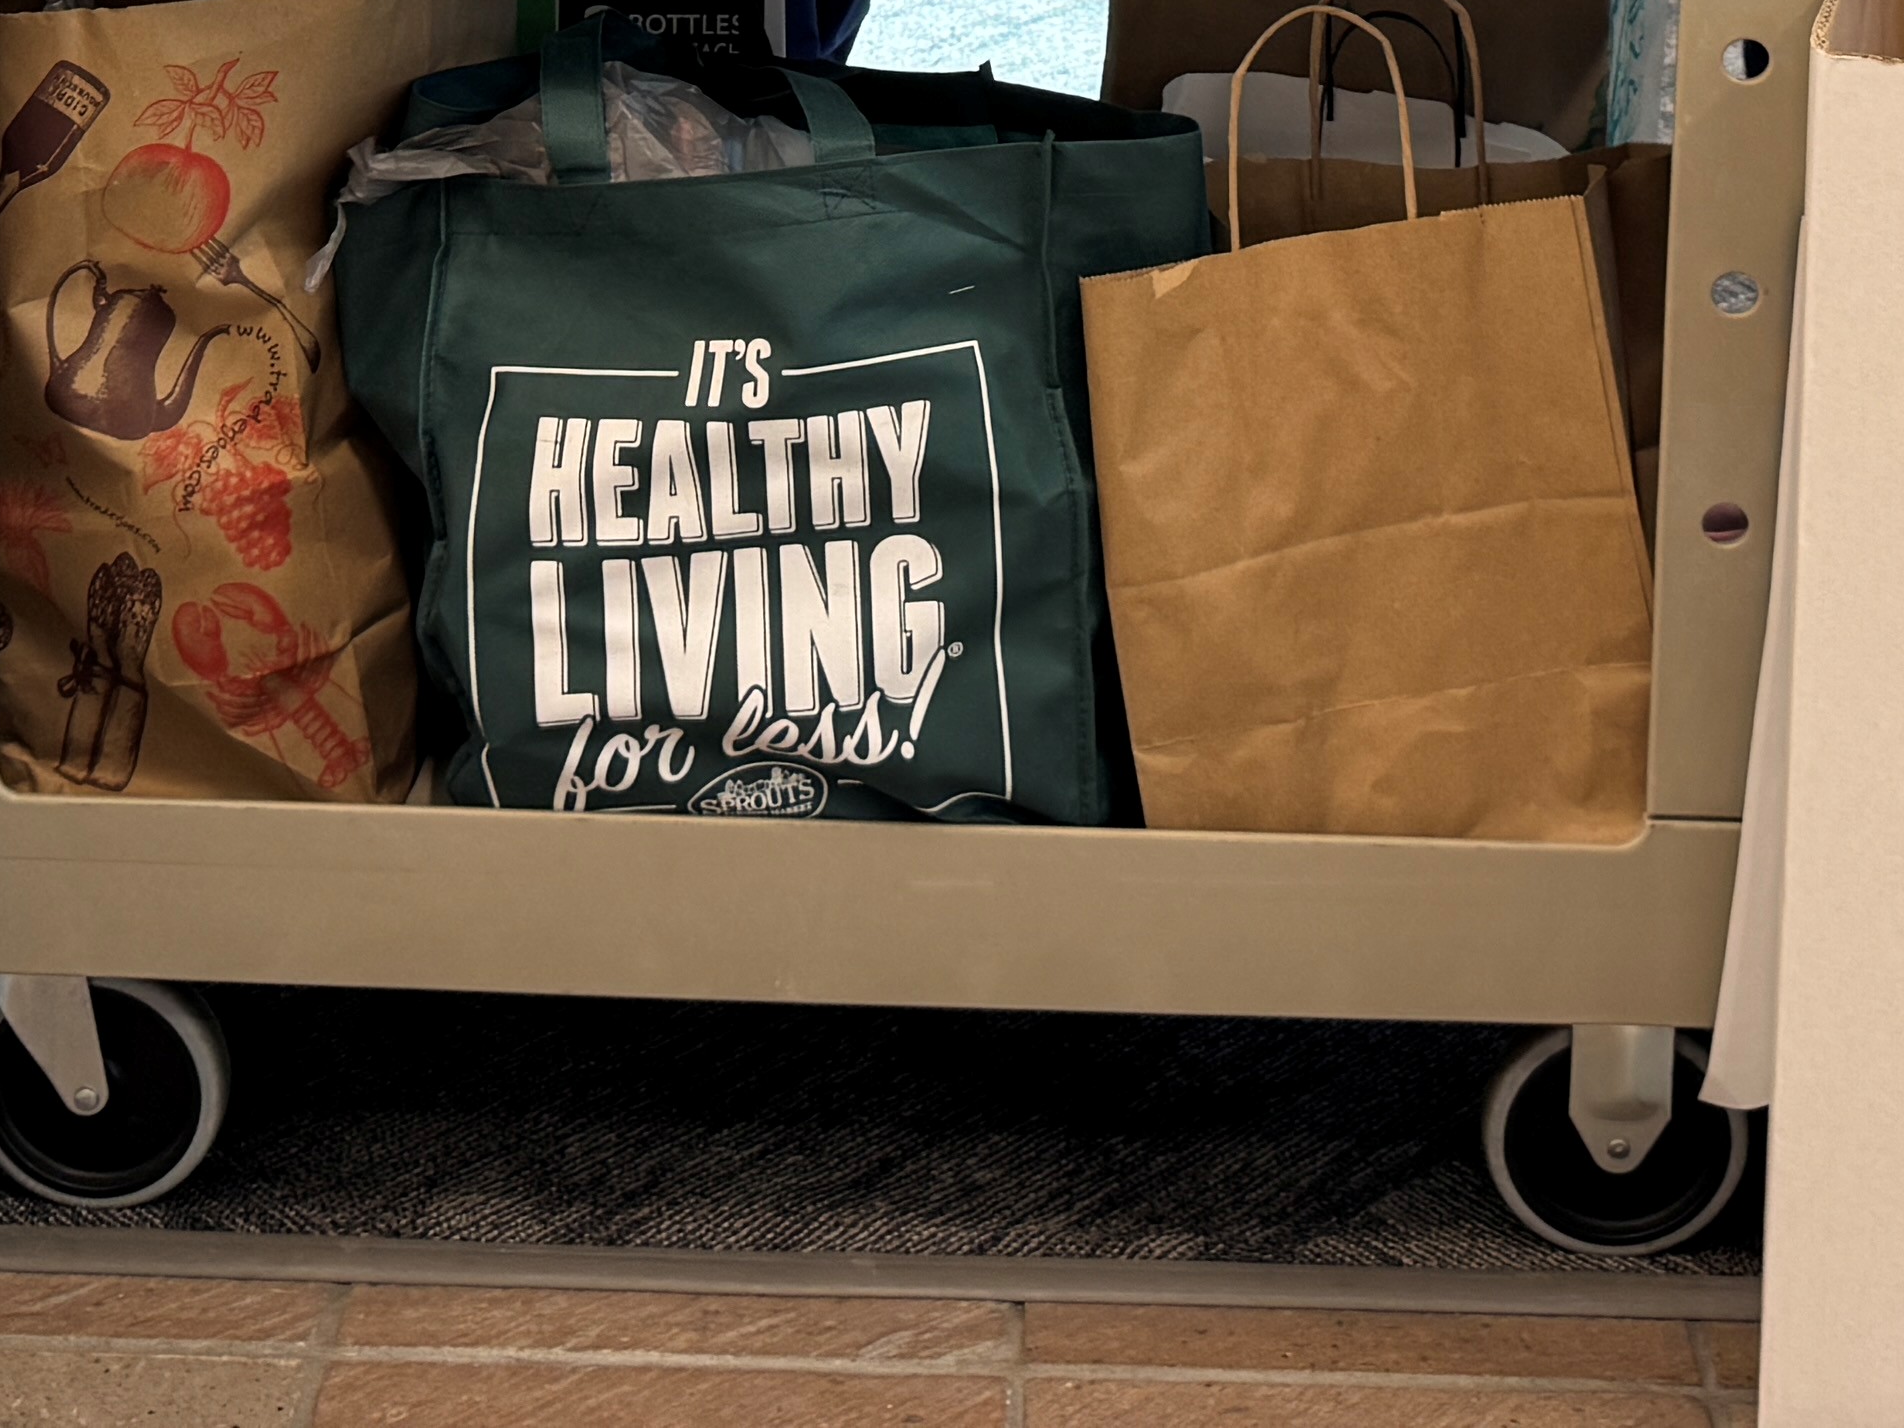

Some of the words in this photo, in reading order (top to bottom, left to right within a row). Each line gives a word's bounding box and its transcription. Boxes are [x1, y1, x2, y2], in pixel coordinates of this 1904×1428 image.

[177, 324, 288, 513] www.traderjoes.com
[684, 338, 772, 408] IT'S
[529, 399, 931, 548] HEALTHY
[529, 533, 945, 728] LIVING
[552, 716, 696, 813] for
[722, 648, 946, 766] less!
[699, 777, 816, 814] SPROUTS
